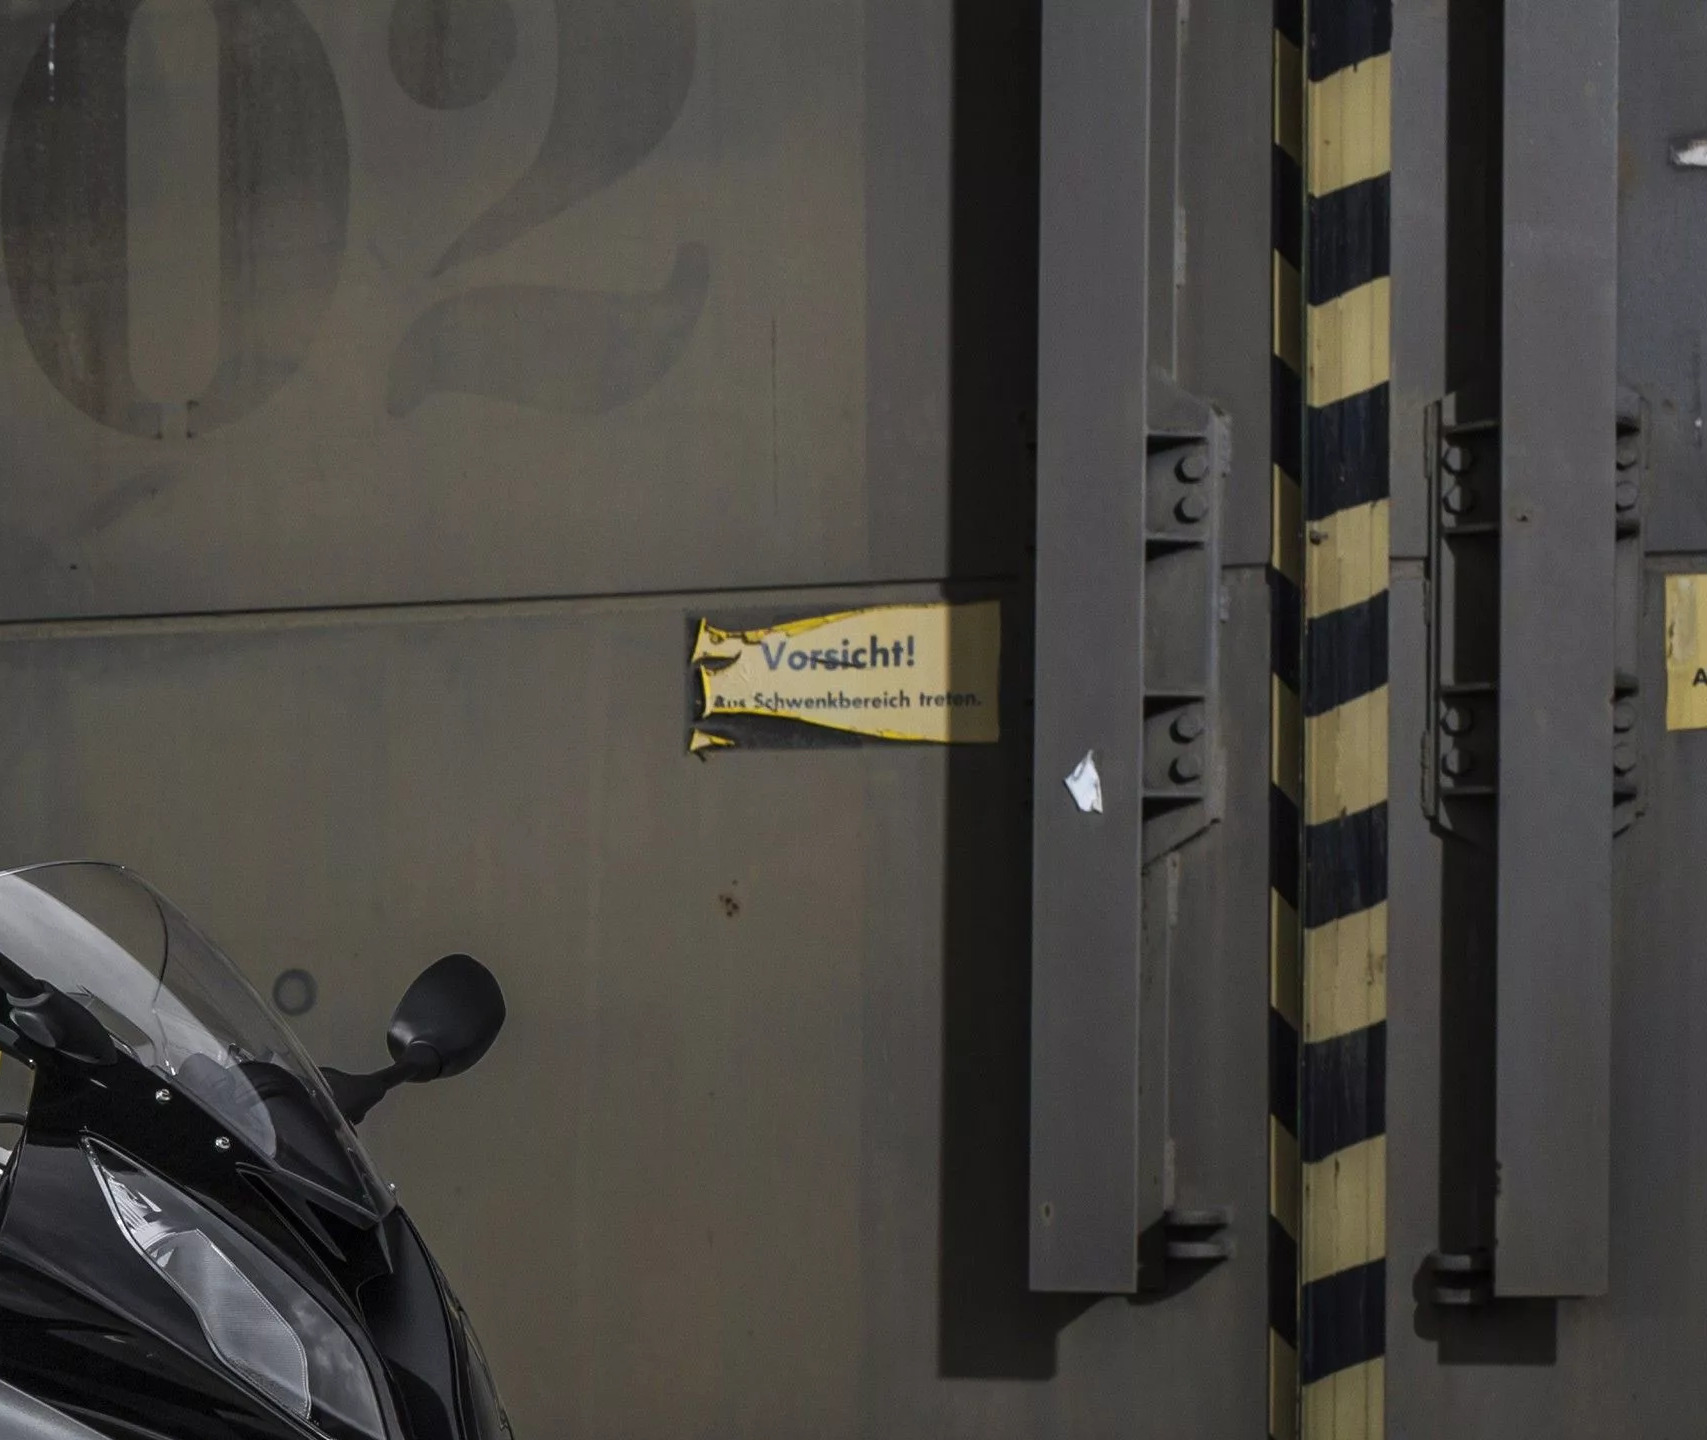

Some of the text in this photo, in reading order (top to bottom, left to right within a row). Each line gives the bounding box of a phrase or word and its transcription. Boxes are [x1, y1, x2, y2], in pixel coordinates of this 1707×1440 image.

[0, 0, 710, 438] 02
[760, 634, 915, 671] Vorsicht!
[753, 690, 911, 712] Schwenkbereich
